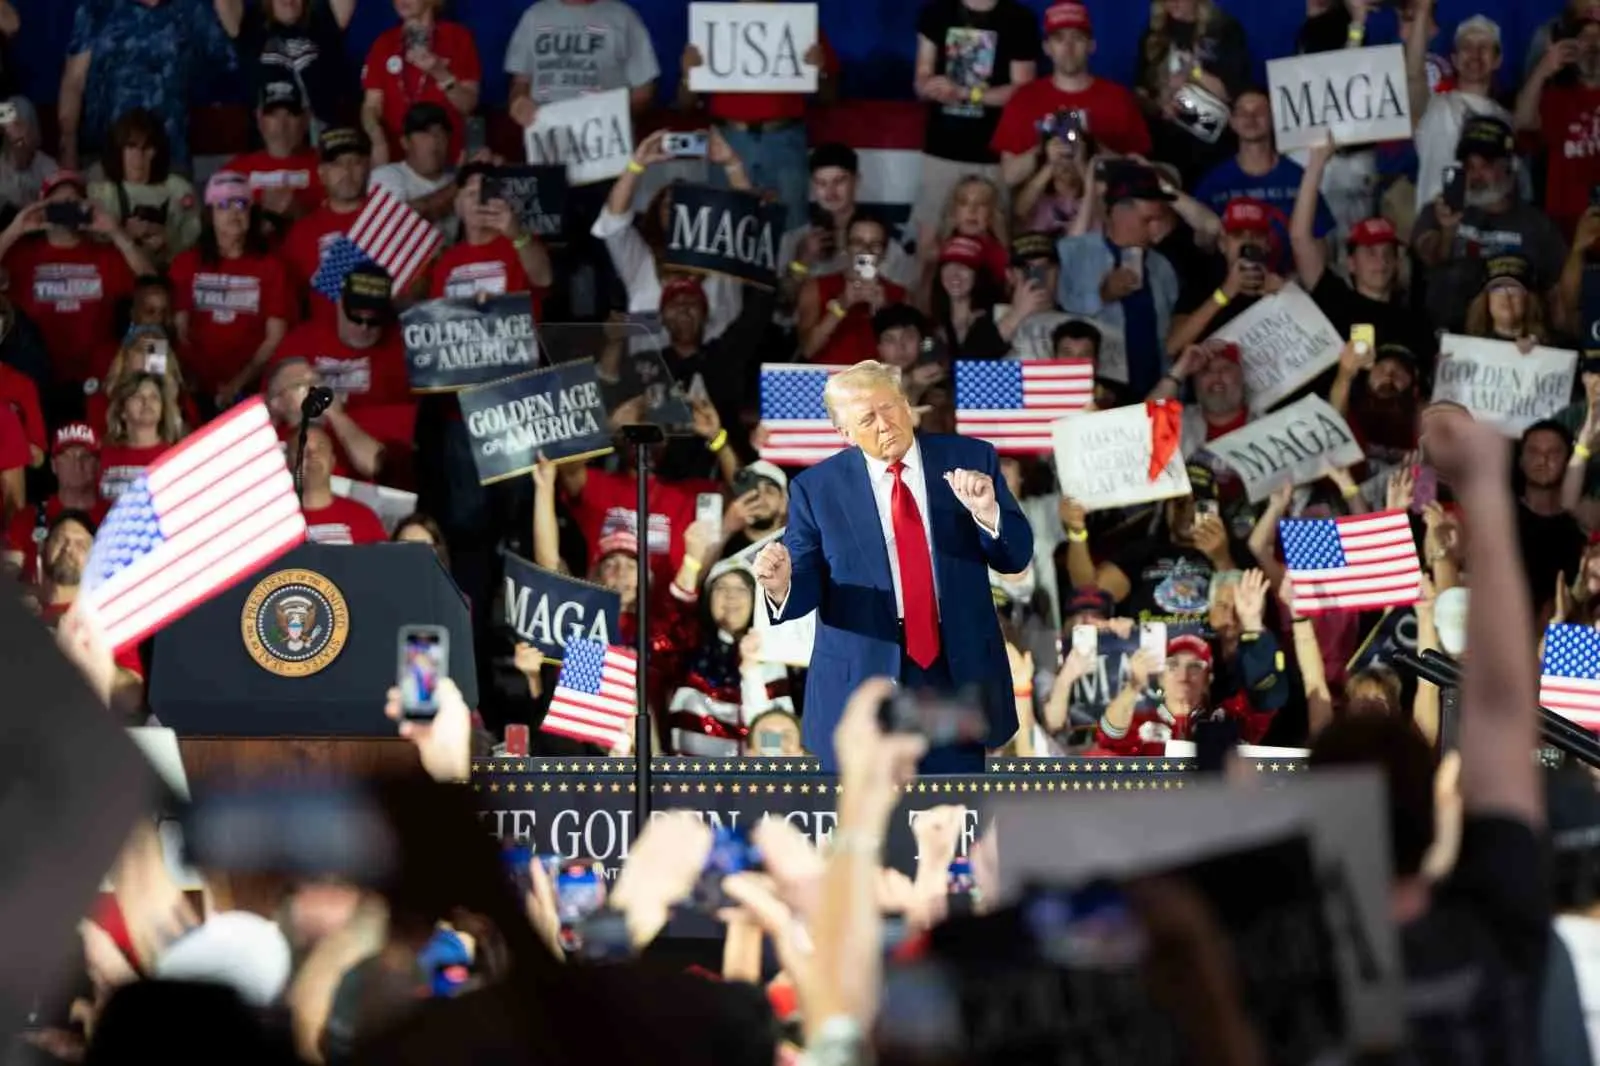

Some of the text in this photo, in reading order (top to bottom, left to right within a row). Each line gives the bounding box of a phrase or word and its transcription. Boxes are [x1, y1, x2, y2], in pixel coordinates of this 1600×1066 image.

[535, 32, 605, 55] GULF
[705, 20, 804, 79] USA
[1276, 71, 1405, 133] MAGA
[531, 114, 628, 167] MAGA
[669, 203, 776, 270] MAGA
[404, 312, 534, 350] GOLDEN AGE
[437, 339, 530, 371] AMERICA
[1441, 360, 1569, 397] GOLDEN AGE
[56, 423, 95, 444] MAGA
[469, 391, 556, 438] GOLDEN
[557, 381, 600, 411] AGE
[504, 410, 600, 454] AMERICA
[1227, 412, 1352, 482] MAGA
[246, 572, 293, 621] PRESIDENT
[324, 585, 345, 629] UNITED
[504, 575, 610, 649] MAGA
